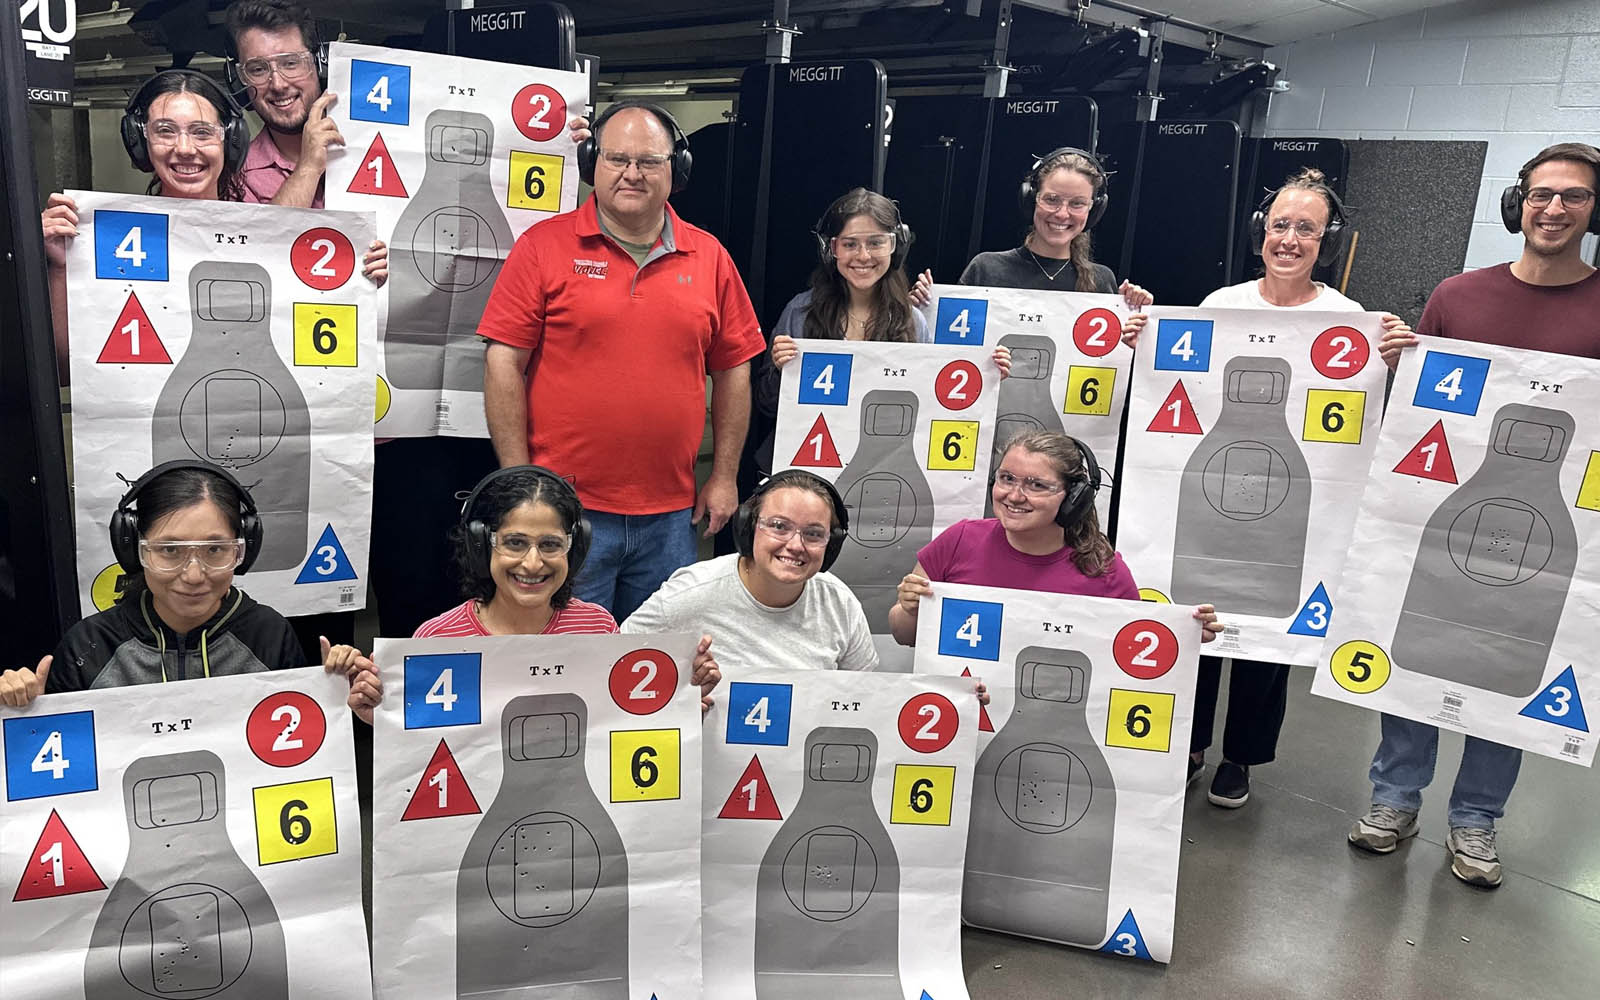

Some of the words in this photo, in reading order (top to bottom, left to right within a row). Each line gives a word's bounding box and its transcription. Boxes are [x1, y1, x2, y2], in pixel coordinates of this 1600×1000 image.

[367, 76, 392, 111] 4
[528, 94, 551, 129] 2
[368, 156, 382, 188] 1
[525, 166, 545, 199] 6
[115, 227, 146, 266] 4
[311, 239, 336, 276] 2
[122, 319, 139, 355] 1
[313, 318, 337, 354] 6
[949, 309, 970, 337] 4
[1086, 317, 1107, 346] 2
[1171, 331, 1194, 361] 4
[1327, 336, 1352, 367] 2
[813, 365, 834, 395] 4
[948, 370, 968, 399] 2
[1080, 378, 1099, 405] 6
[1435, 368, 1463, 400] 4
[1168, 400, 1181, 427] 1
[1322, 402, 1344, 432] 6
[810, 434, 822, 460] 1
[943, 432, 961, 461] 6
[1421, 442, 1438, 472] 1
[316, 546, 337, 575] 3
[956, 614, 981, 647] 4
[1307, 602, 1327, 629] 3
[1131, 631, 1159, 667] 2
[629, 660, 657, 699] 2
[1348, 652, 1374, 682] 5
[426, 669, 457, 711] 4
[1545, 686, 1571, 716] 3
[271, 705, 303, 751] 2
[745, 697, 771, 732] 4
[915, 704, 941, 739] 2
[1127, 705, 1151, 737] 6
[32, 732, 69, 779] 4
[632, 746, 658, 788] 6
[429, 768, 447, 808] 1
[742, 779, 757, 811] 1
[910, 779, 933, 813] 6
[280, 800, 311, 845] 6
[41, 842, 64, 886] 1
[1115, 933, 1136, 955] 3
